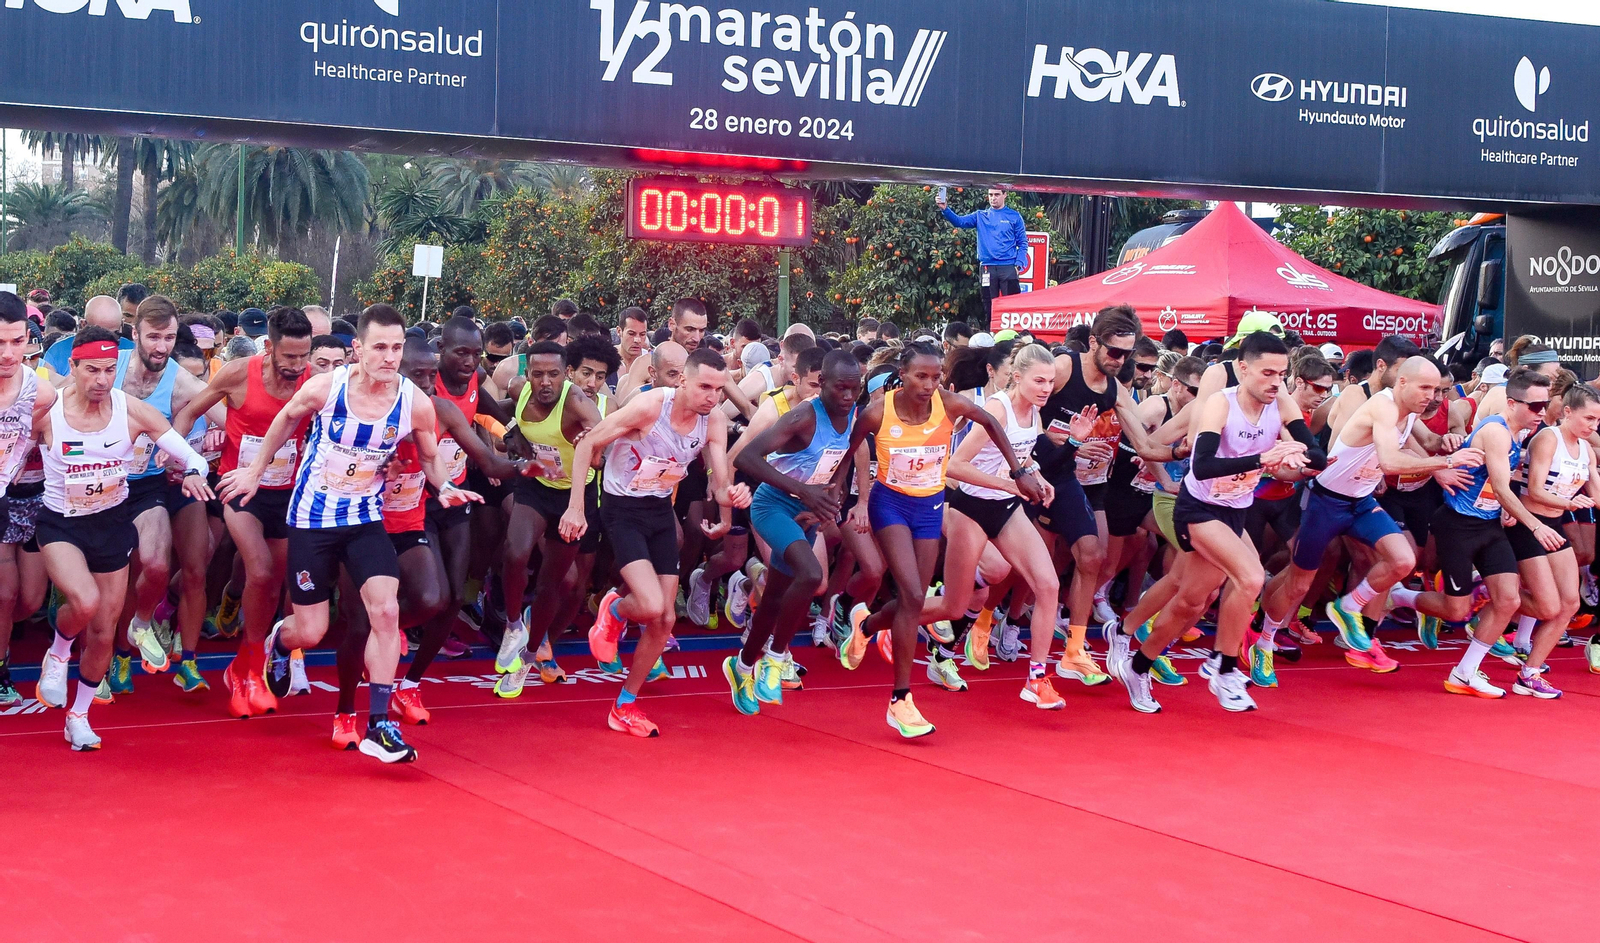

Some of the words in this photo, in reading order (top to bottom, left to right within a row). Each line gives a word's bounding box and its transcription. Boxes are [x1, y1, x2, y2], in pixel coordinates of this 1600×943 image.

[301, 21, 482, 57] quirónsalud
[661, 3, 894, 60] maratón
[315, 60, 402, 83] Healthcare
[408, 67, 467, 88] Partner
[722, 52, 897, 105] sevilla
[1028, 45, 1181, 107] HOKA
[1300, 79, 1407, 108] HYUNDAI
[690, 107, 718, 131] 28
[725, 115, 792, 137] enero
[799, 116, 854, 141] 2024
[1299, 108, 1367, 127] Hyundauto
[1369, 113, 1406, 129] Motor
[1481, 149, 1538, 166] Healthcare
[1540, 151, 1579, 167] Partner
[640, 189, 803, 237] 00:00:01
[1363, 309, 1436, 336] alssport.
[1544, 336, 1600, 350] HYUNDA
[1557, 353, 1583, 363] ndauto
[346, 463, 357, 477] 8
[908, 458, 924, 471] 15
[85, 482, 104, 496] 54
[392, 483, 402, 495] 3
